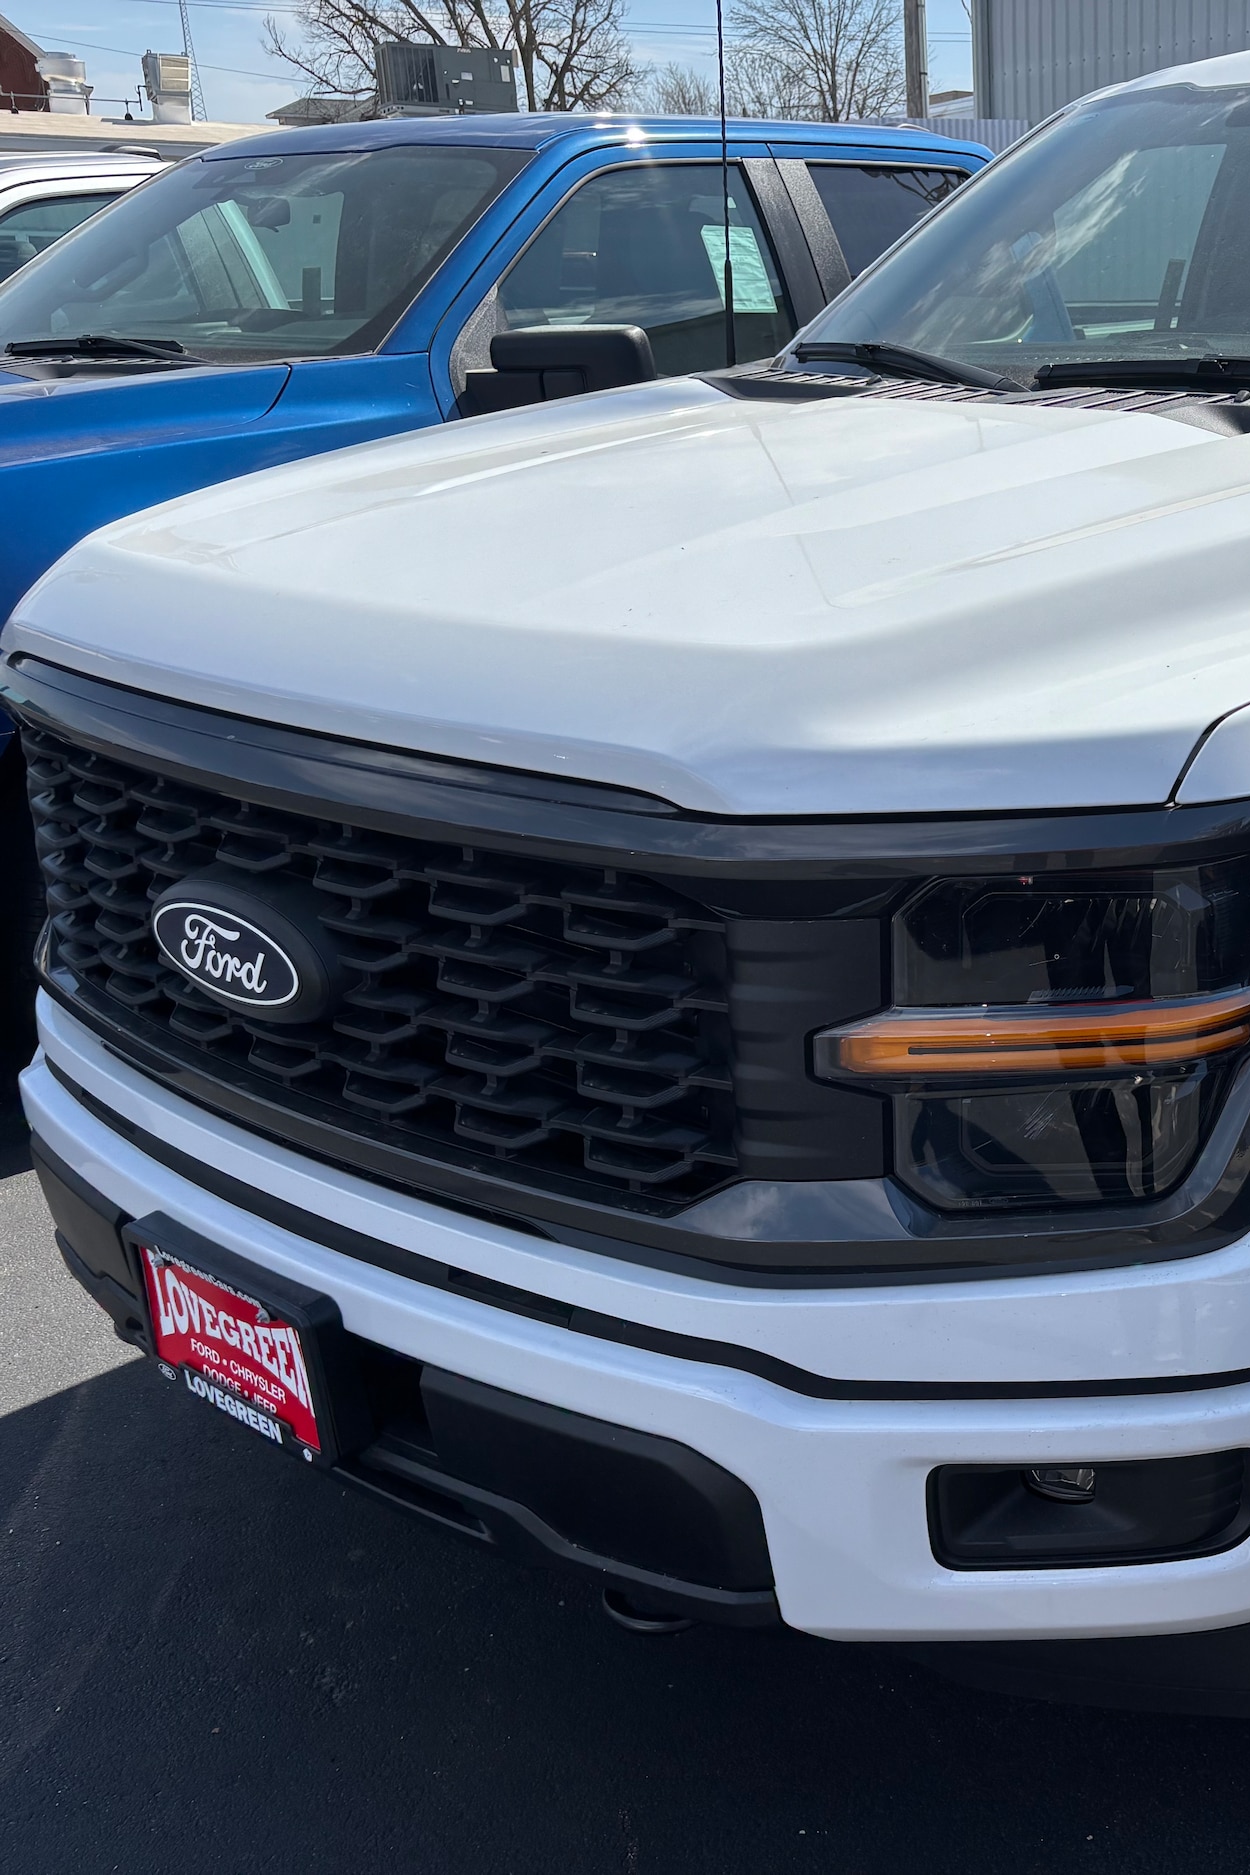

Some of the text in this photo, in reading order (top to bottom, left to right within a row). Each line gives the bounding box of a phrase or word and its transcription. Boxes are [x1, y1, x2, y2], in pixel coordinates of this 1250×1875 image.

[180, 913, 268, 994] Ford
[145, 1247, 316, 1419] LOVEGREEN
[190, 1337, 287, 1405] FORD CHRYSLER
[183, 1368, 284, 1445] LOVEGREEN
[202, 1363, 242, 1394] DODGE
[251, 1392, 278, 1415] JEEP
